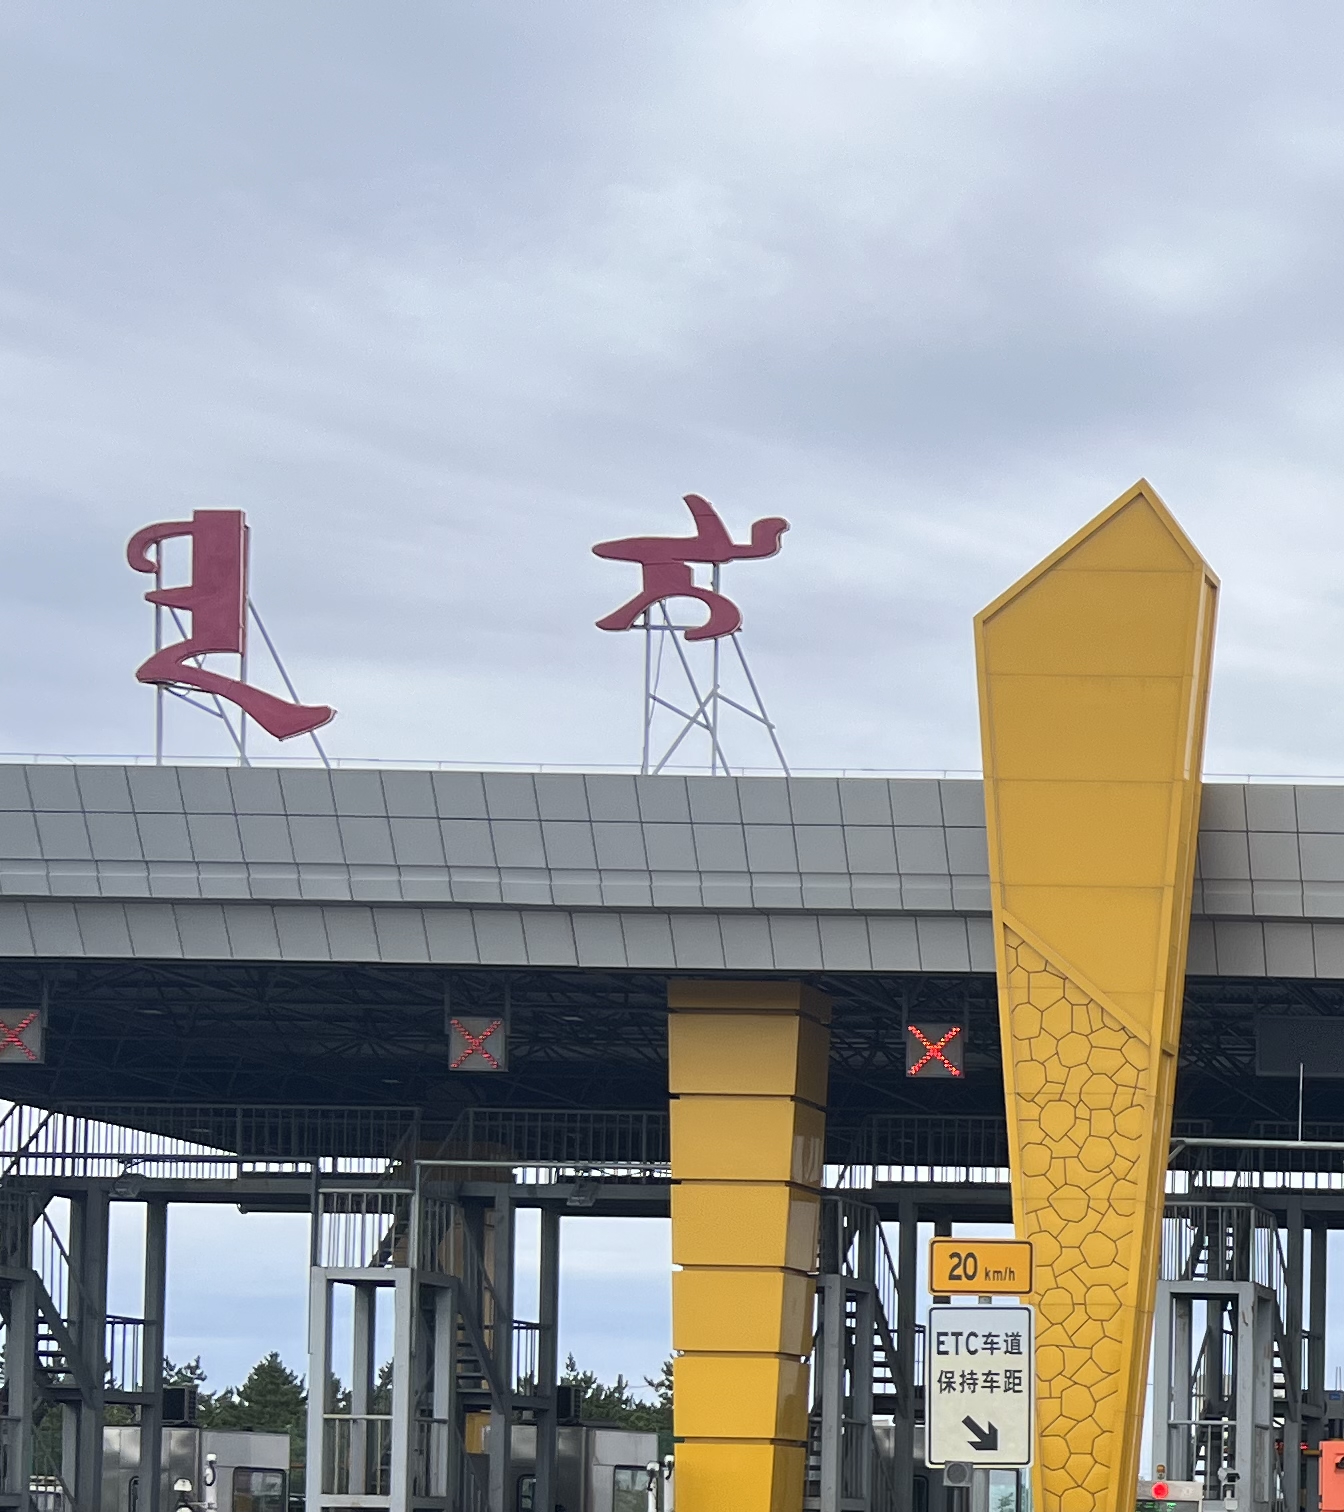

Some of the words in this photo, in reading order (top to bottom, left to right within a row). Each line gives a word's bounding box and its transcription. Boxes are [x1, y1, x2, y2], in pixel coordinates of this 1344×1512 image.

[948, 1251, 979, 1282] 20
[984, 1266, 1016, 1282] km/h
[936, 1331, 1024, 1356] ETC车道
[936, 1369, 1024, 1395] 保持车距
